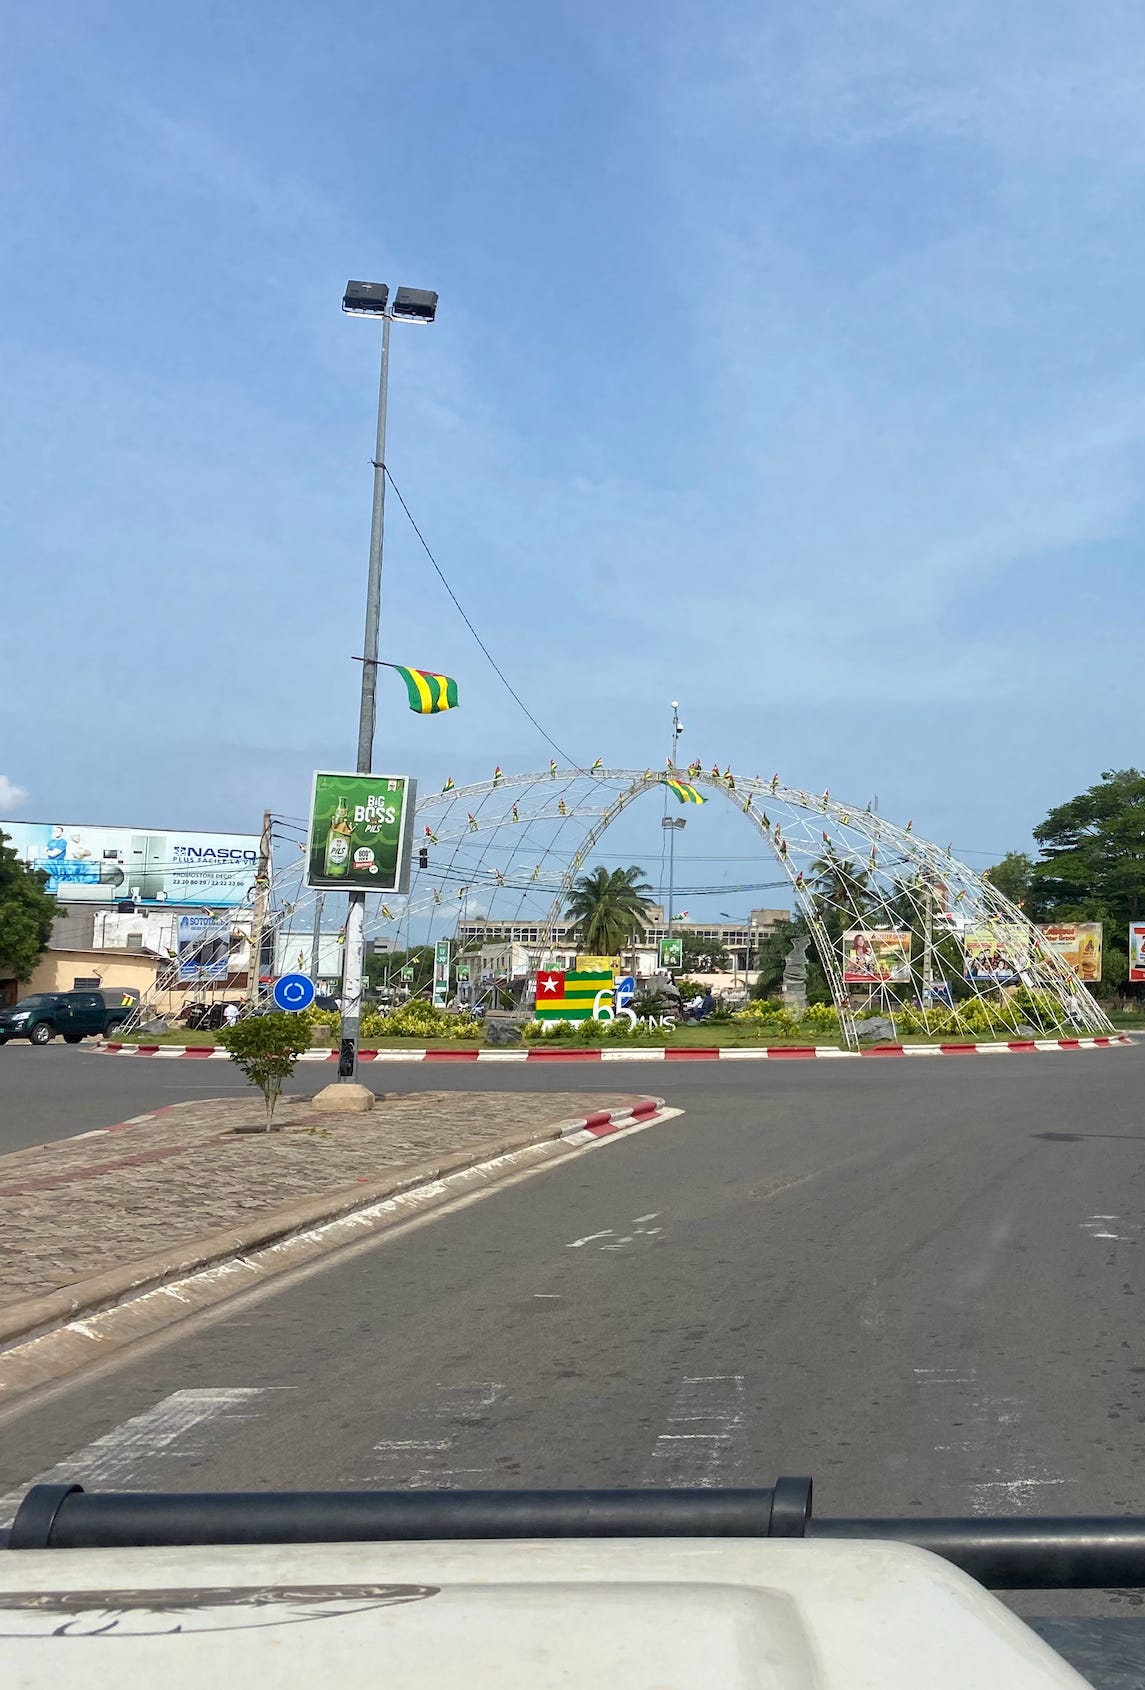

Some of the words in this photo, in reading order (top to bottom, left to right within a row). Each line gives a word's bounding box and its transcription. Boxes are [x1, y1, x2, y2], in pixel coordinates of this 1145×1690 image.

[353, 805, 396, 824] BOSS
[364, 824, 383, 833] PILS
[187, 847, 257, 860] NASCO
[593, 989, 637, 1032] 65
